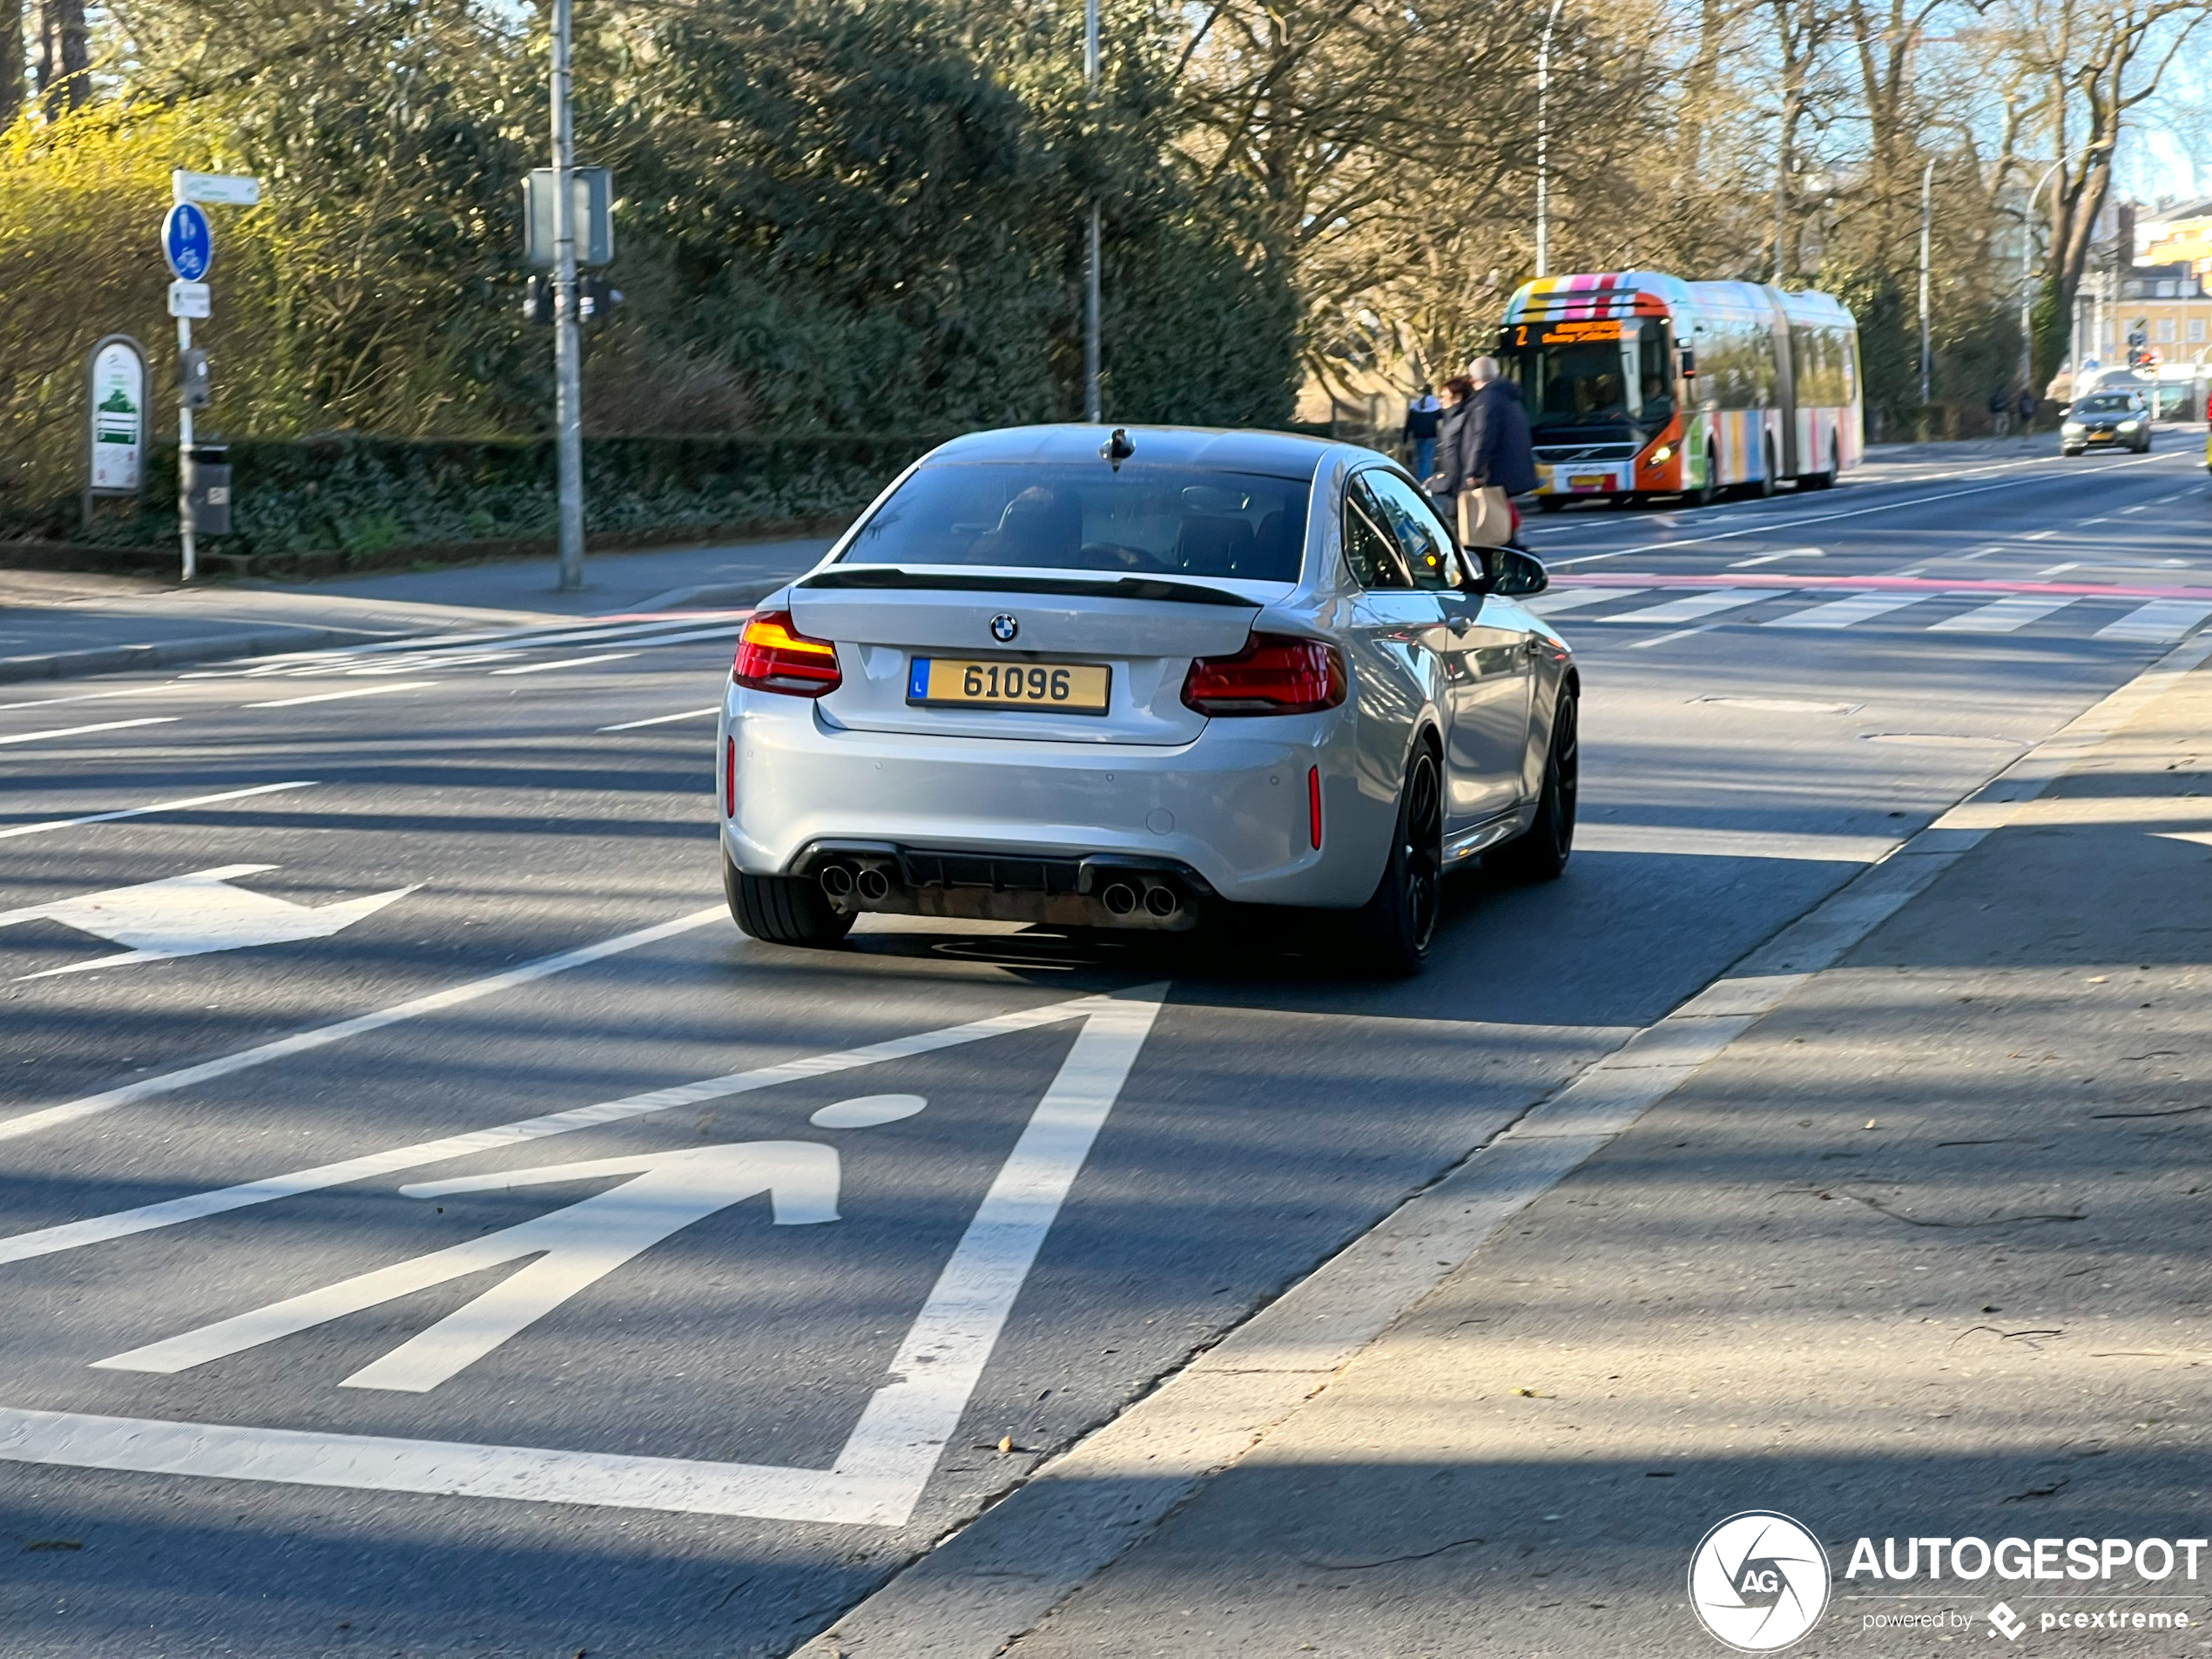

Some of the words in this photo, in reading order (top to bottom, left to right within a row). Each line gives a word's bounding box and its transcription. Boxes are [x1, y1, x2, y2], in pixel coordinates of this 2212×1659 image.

[1516, 326, 1528, 346] 2
[915, 682, 921, 692] L
[963, 665, 1070, 700] 61096
